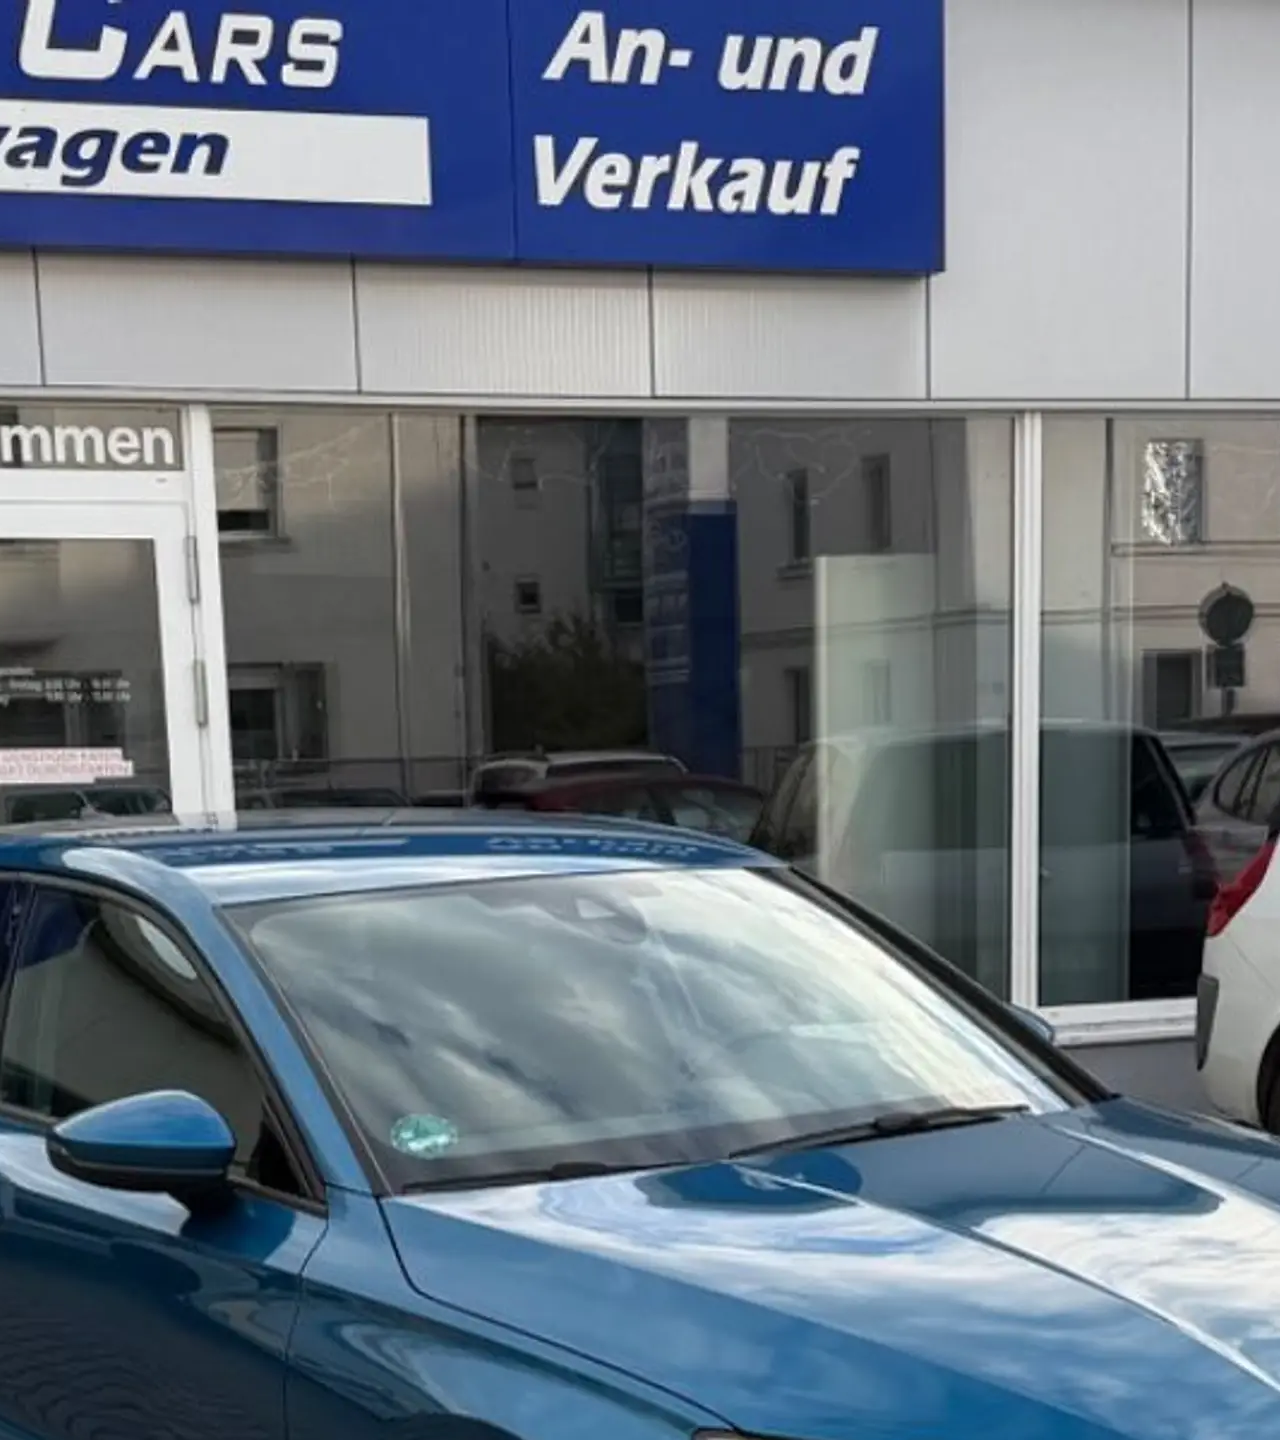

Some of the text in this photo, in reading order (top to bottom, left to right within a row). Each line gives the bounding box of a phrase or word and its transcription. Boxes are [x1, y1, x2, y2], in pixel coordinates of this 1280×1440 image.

[543, 11, 878, 95] An- und
[533, 134, 861, 216] Verkauf
